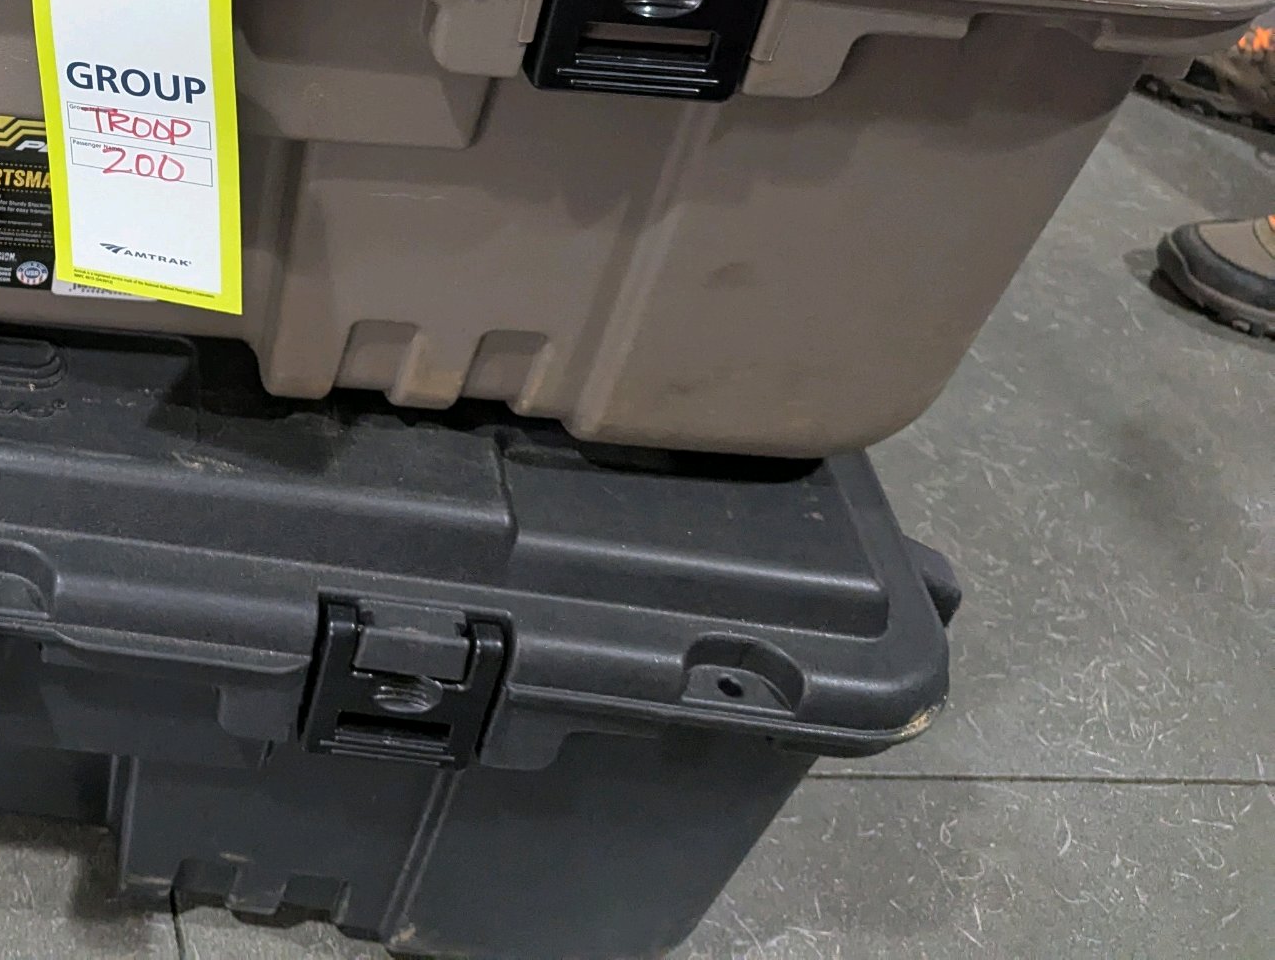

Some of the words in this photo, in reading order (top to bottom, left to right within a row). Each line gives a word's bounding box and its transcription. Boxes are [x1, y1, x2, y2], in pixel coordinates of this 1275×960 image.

[66, 61, 206, 104] GROUP
[81, 107, 192, 145] TROOP
[72, 139, 102, 149] Passenger
[102, 148, 185, 182] 200
[124, 249, 189, 267] AMTRAK
